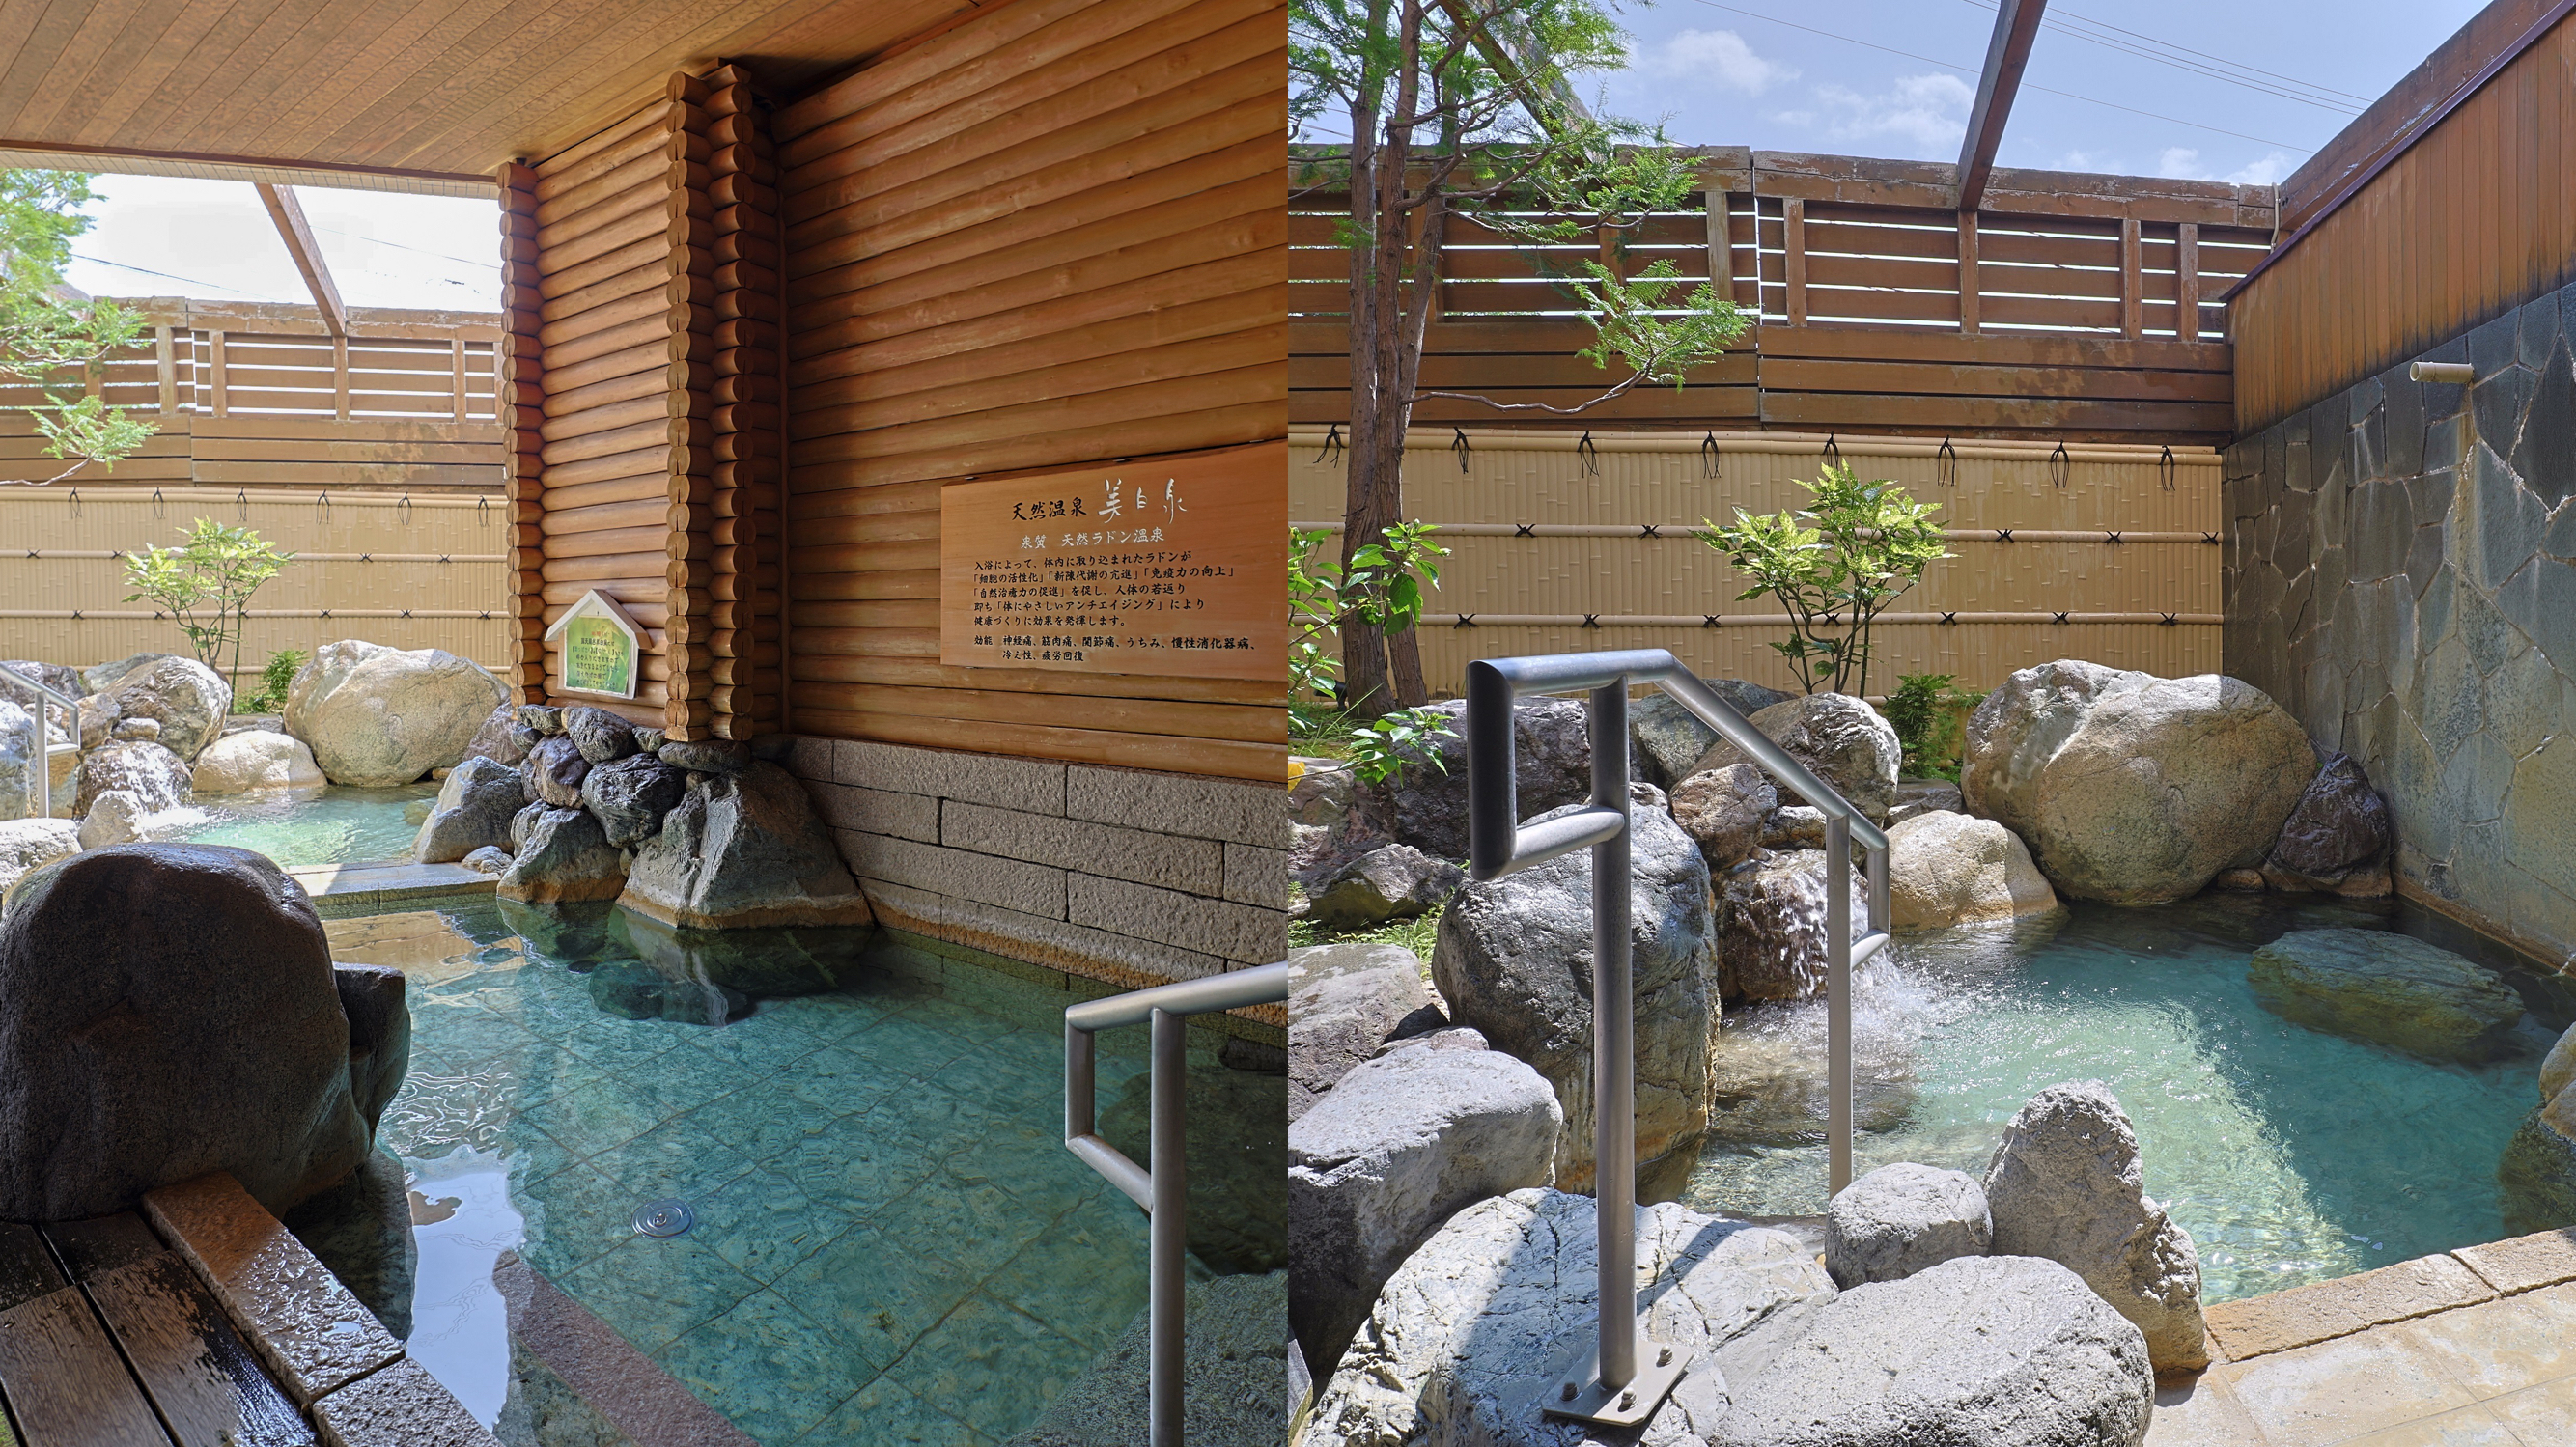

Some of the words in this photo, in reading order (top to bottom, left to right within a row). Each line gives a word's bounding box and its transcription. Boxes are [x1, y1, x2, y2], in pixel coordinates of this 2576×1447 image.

[1012, 496, 1087, 521] 天然温泉
[1020, 534, 1047, 549] 泉質
[1061, 526, 1164, 547] 天然ラドン温泉
[973, 634, 994, 646] 効能
[1002, 650, 1084, 662] 冷え性、疲労回復
